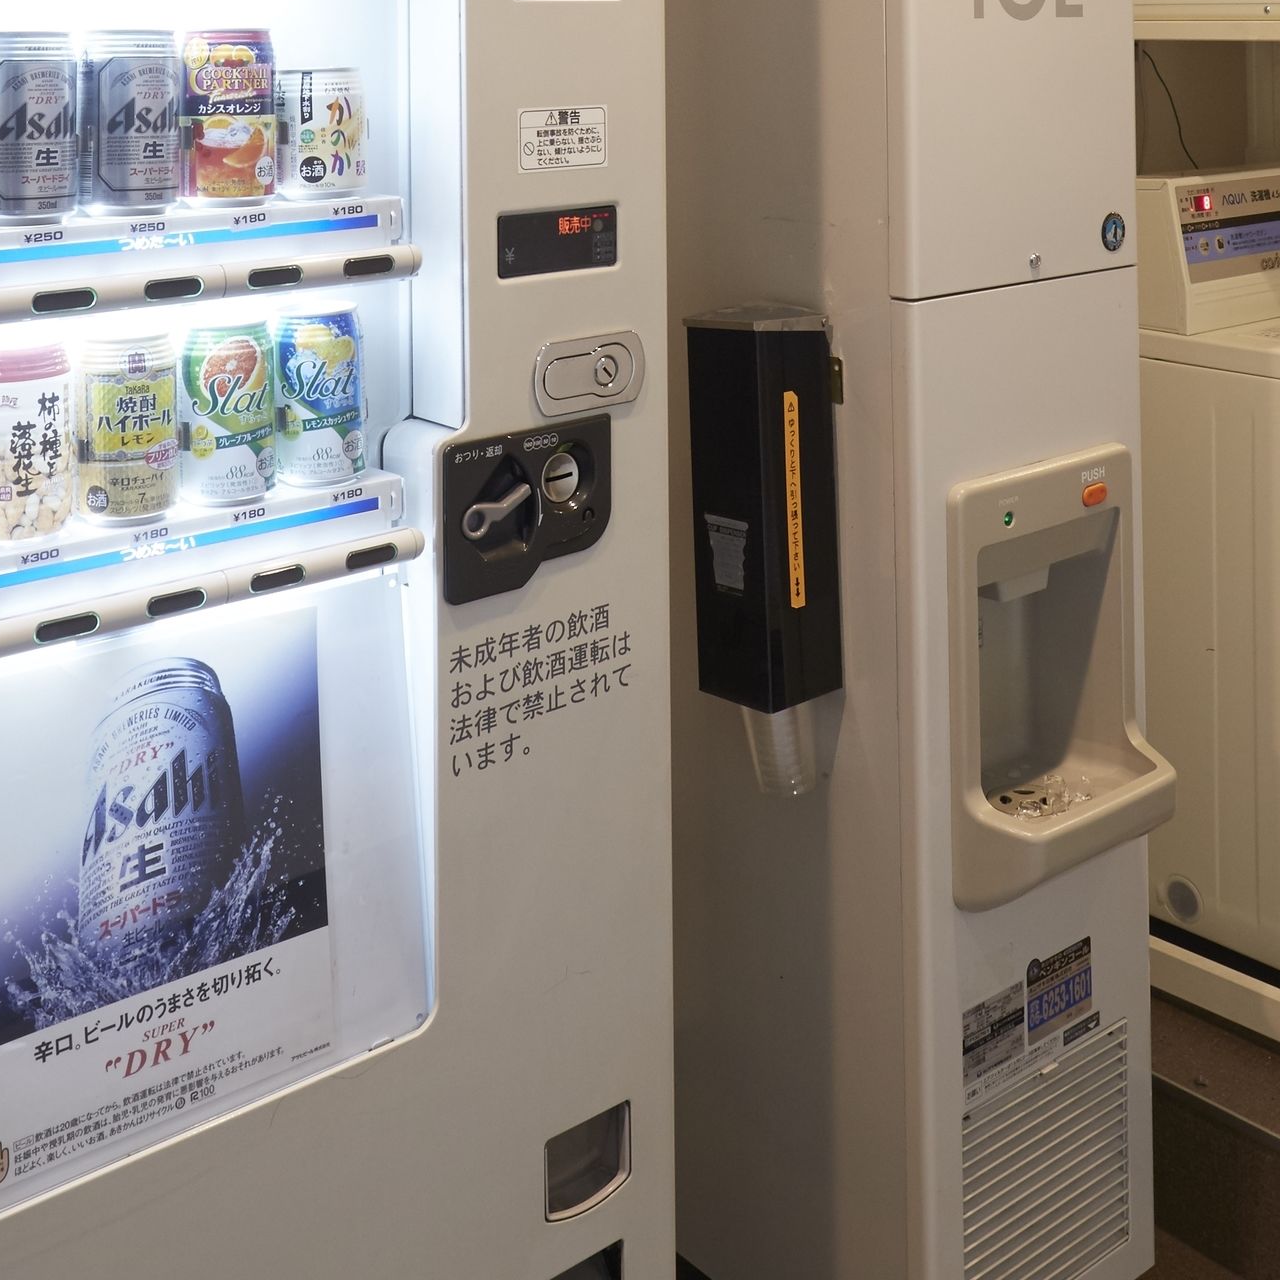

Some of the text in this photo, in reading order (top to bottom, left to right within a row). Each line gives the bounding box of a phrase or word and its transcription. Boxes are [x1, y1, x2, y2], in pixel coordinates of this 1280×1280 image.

[201, 66, 269, 81] COCKTAIL
[201, 78, 269, 92] PARTNER
[198, 102, 262, 114] カシスオレンジ
[558, 110, 581, 126] 警告
[325, 95, 353, 177] かのか
[34, 147, 59, 167] 生
[142, 140, 165, 160] 生
[537, 156, 571, 167] てください。
[20, 172, 70, 184] スーパードライ
[129, 166, 175, 177] スーパードライ
[300, 163, 325, 178] お酒
[144, 190, 164, 201] 350ml
[1222, 191, 1248, 206] AQUA
[1249, 189, 1271, 203] 洗濯機
[37, 199, 58, 210] 350ml
[332, 204, 363, 217] ¥180
[130, 221, 166, 233] ¥250
[233, 212, 267, 225] ¥180
[558, 216, 593, 235] 販売中
[24, 229, 64, 242] ¥250
[281, 359, 356, 401] Slat
[116, 393, 158, 415] 焼酎
[191, 375, 270, 418] Slat
[96, 408, 175, 434] ハイボール
[305, 412, 358, 429] レモンスカッシュサワー
[120, 433, 156, 448] レモン
[8, 420, 43, 497] 落花生
[312, 447, 333, 462] 88
[454, 443, 504, 465] おつり・返却
[109, 472, 164, 488] 辛口チューハイ
[225, 463, 247, 480] 88
[1081, 466, 1106, 483] PUSH
[86, 490, 108, 508] お酒
[332, 488, 363, 503] ¥180
[232, 506, 266, 523] ¥180
[133, 526, 169, 541] ¥180
[20, 548, 61, 565] ¥300
[449, 602, 610, 675] 未成年者の飲酒
[450, 630, 632, 710] および飲酒運転は
[449, 662, 632, 747] 法律で禁止されて
[163, 711, 197, 732] LIMITED
[451, 732, 531, 778] います。
[81, 749, 223, 869] Asahi
[119, 841, 167, 893] 生
[34, 955, 284, 1065] 辛口。ビールのうまさを切り拓く。
[141, 1017, 186, 1044] SUPER
